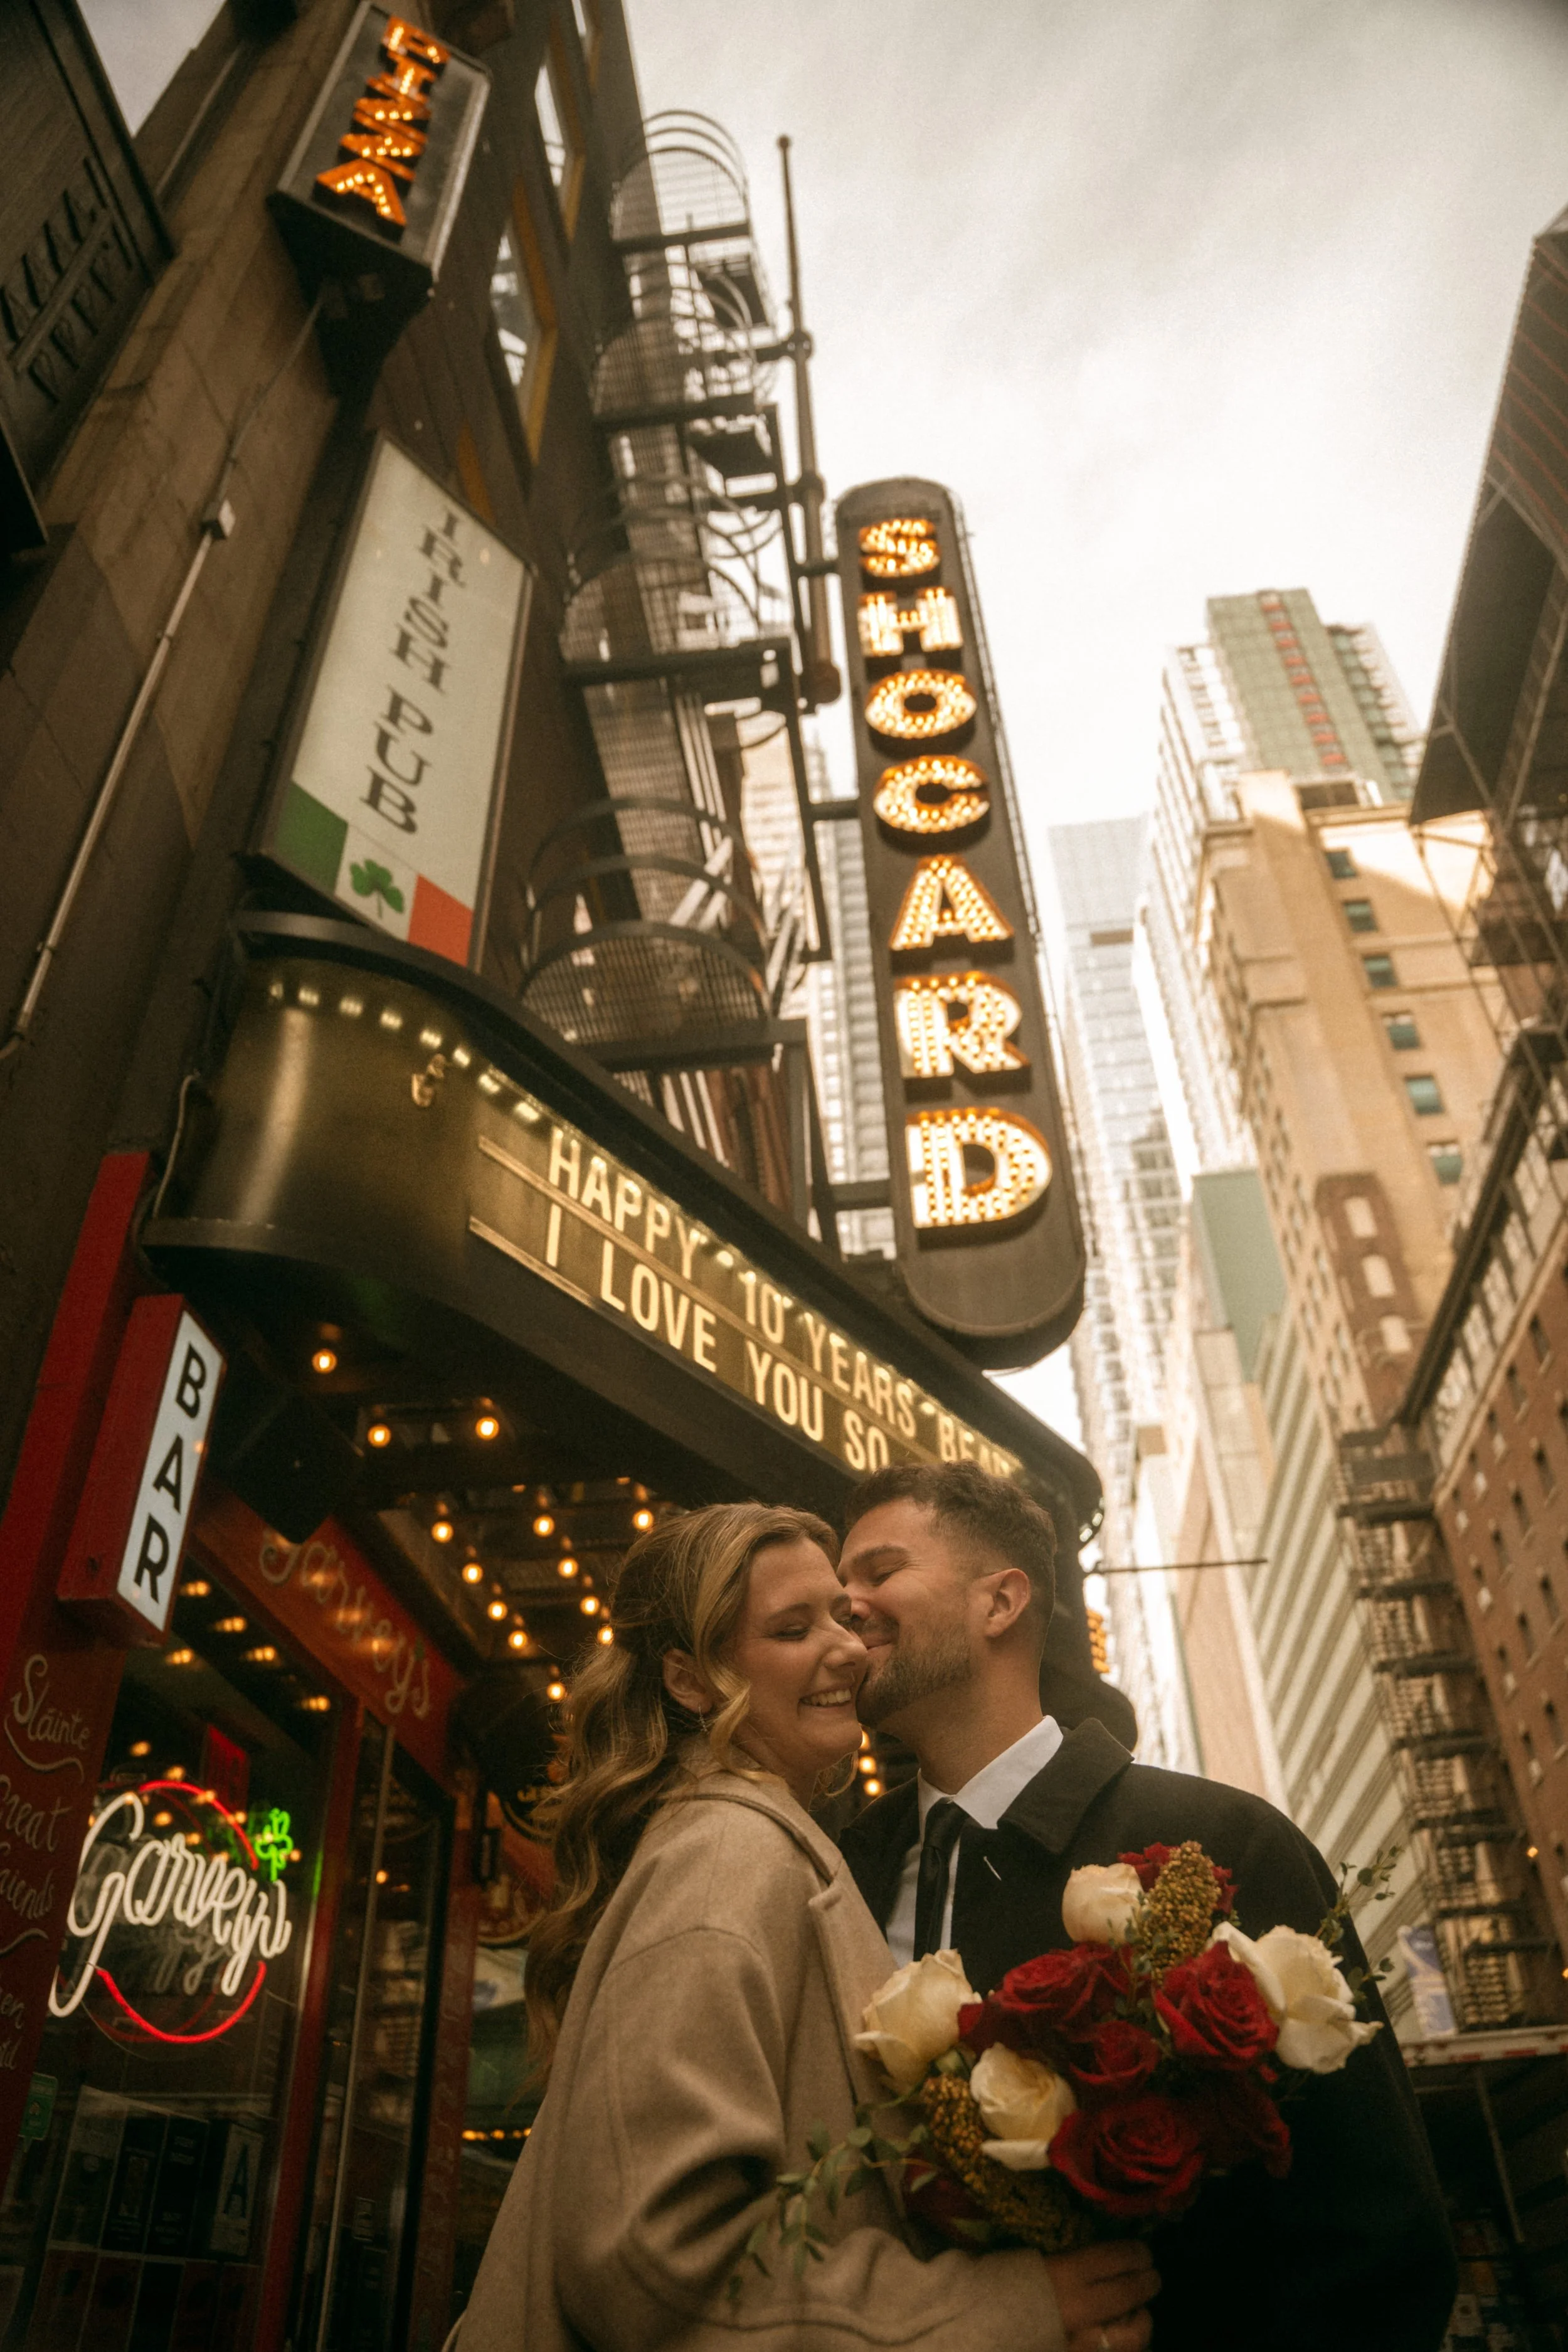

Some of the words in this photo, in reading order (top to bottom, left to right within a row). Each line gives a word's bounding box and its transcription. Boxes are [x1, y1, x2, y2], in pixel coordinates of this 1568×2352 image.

[316, 16, 451, 227] PIZZA
[389, 506, 467, 694] IRISH
[359, 684, 433, 835] PUB
[858, 516, 1052, 1231] SHOCARD
[546, 1203, 562, 1268] I
[600, 1239, 717, 1373] LOVE
[746, 1341, 824, 1442] YOU
[843, 1409, 890, 1473] SO
[548, 1127, 701, 1280] HAPPY
[739, 1271, 785, 1344] 10
[803, 1312, 917, 1438] YEARS
[134, 1342, 206, 1604] BAR
